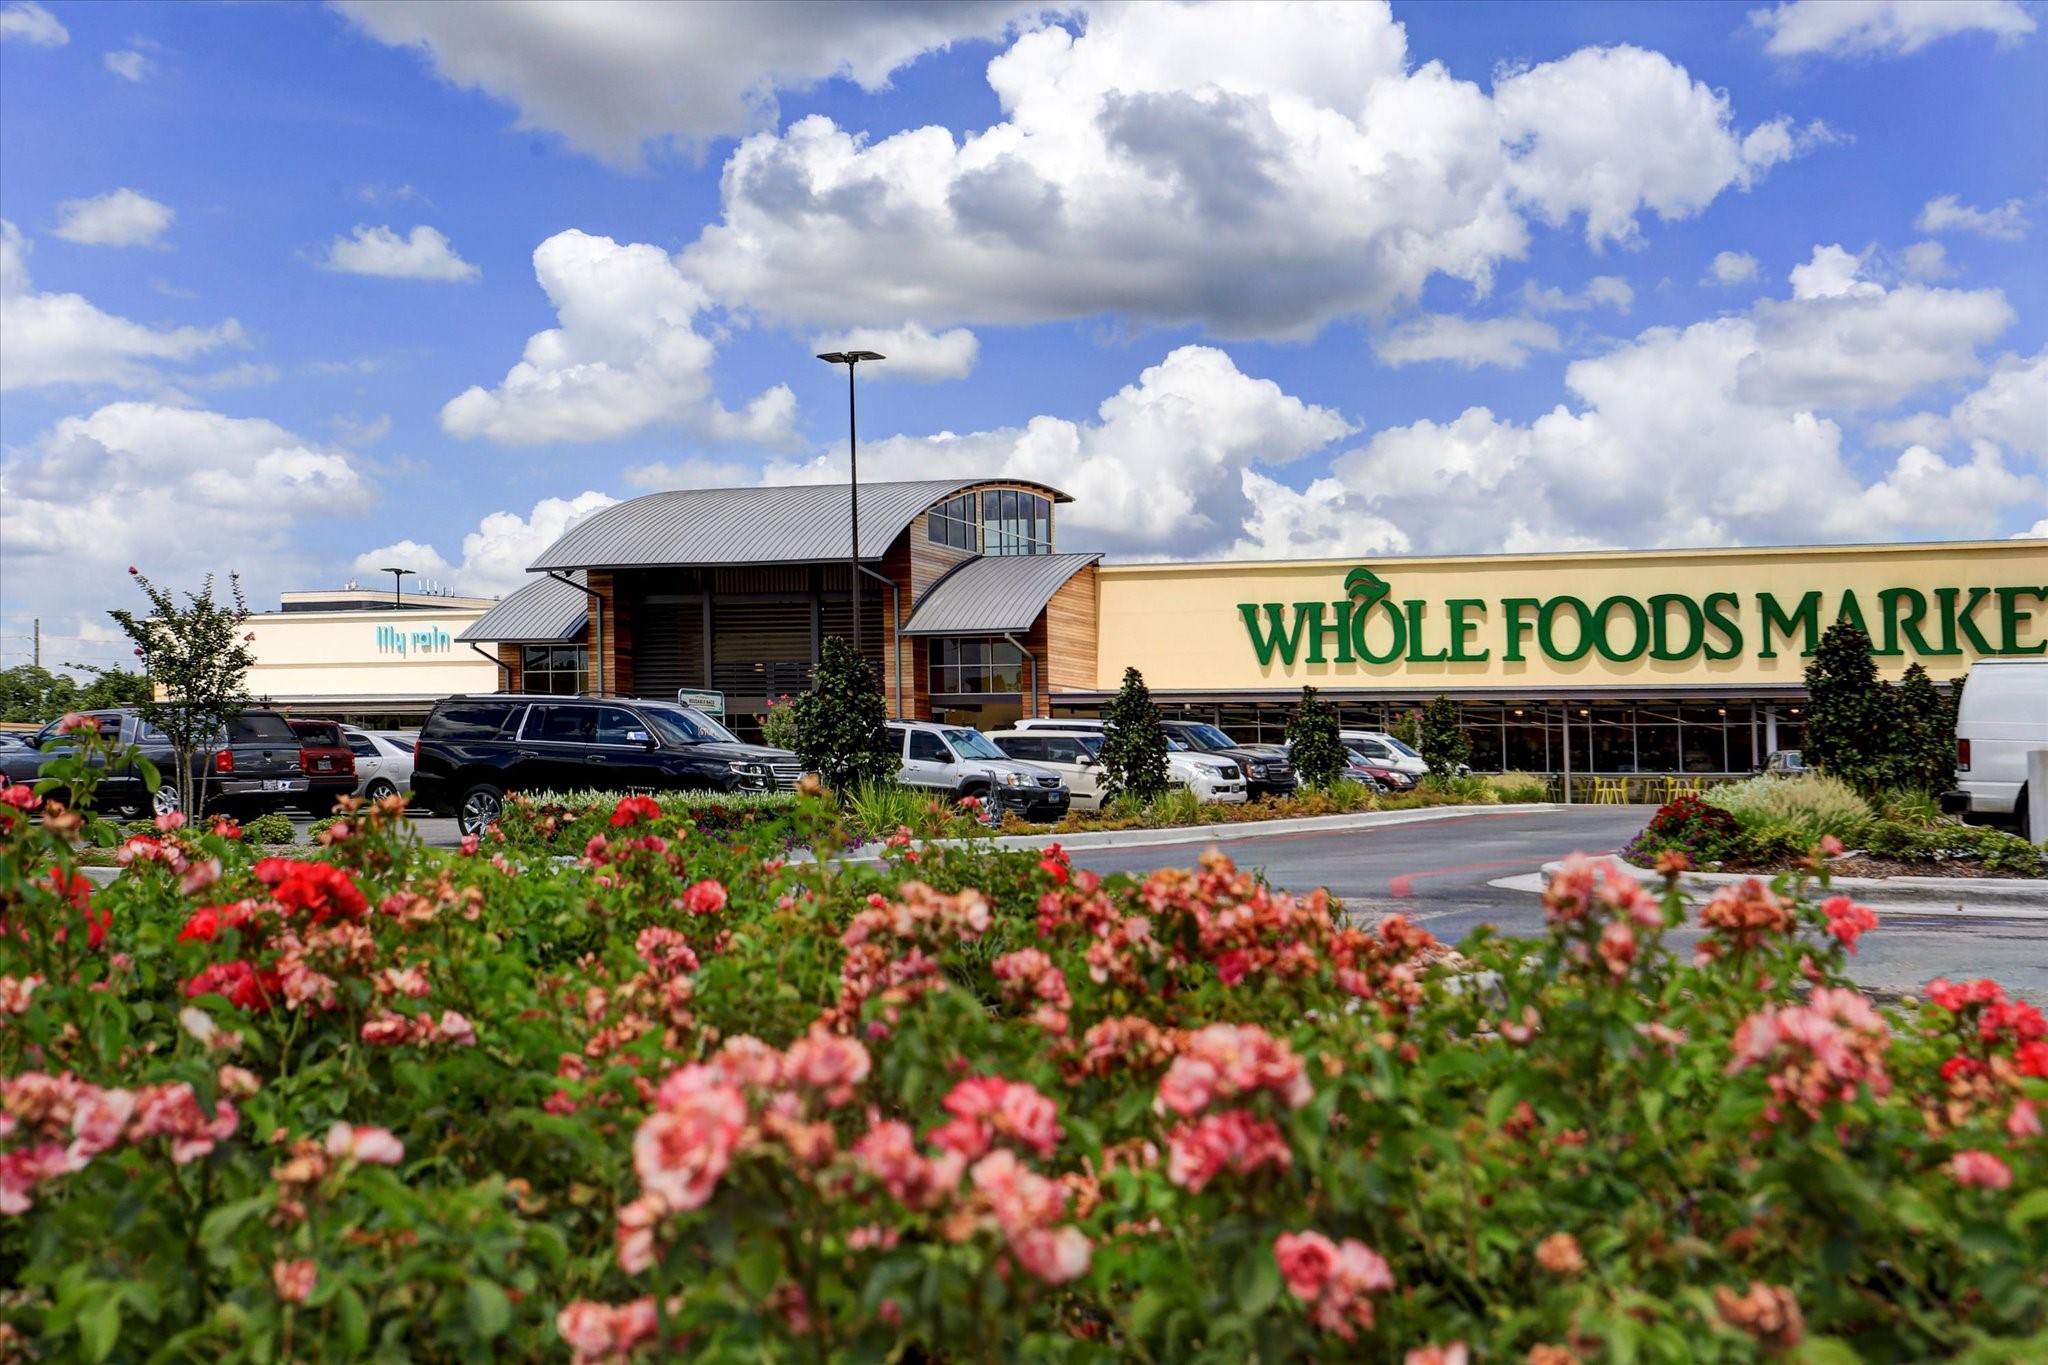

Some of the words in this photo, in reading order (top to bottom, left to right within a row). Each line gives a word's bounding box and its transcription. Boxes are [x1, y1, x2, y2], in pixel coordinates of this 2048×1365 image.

[410, 624, 450, 647] rain
[1237, 568, 1490, 666] WHOLE
[1500, 592, 1744, 662] FOODS
[1755, 586, 2048, 658] MARKE
